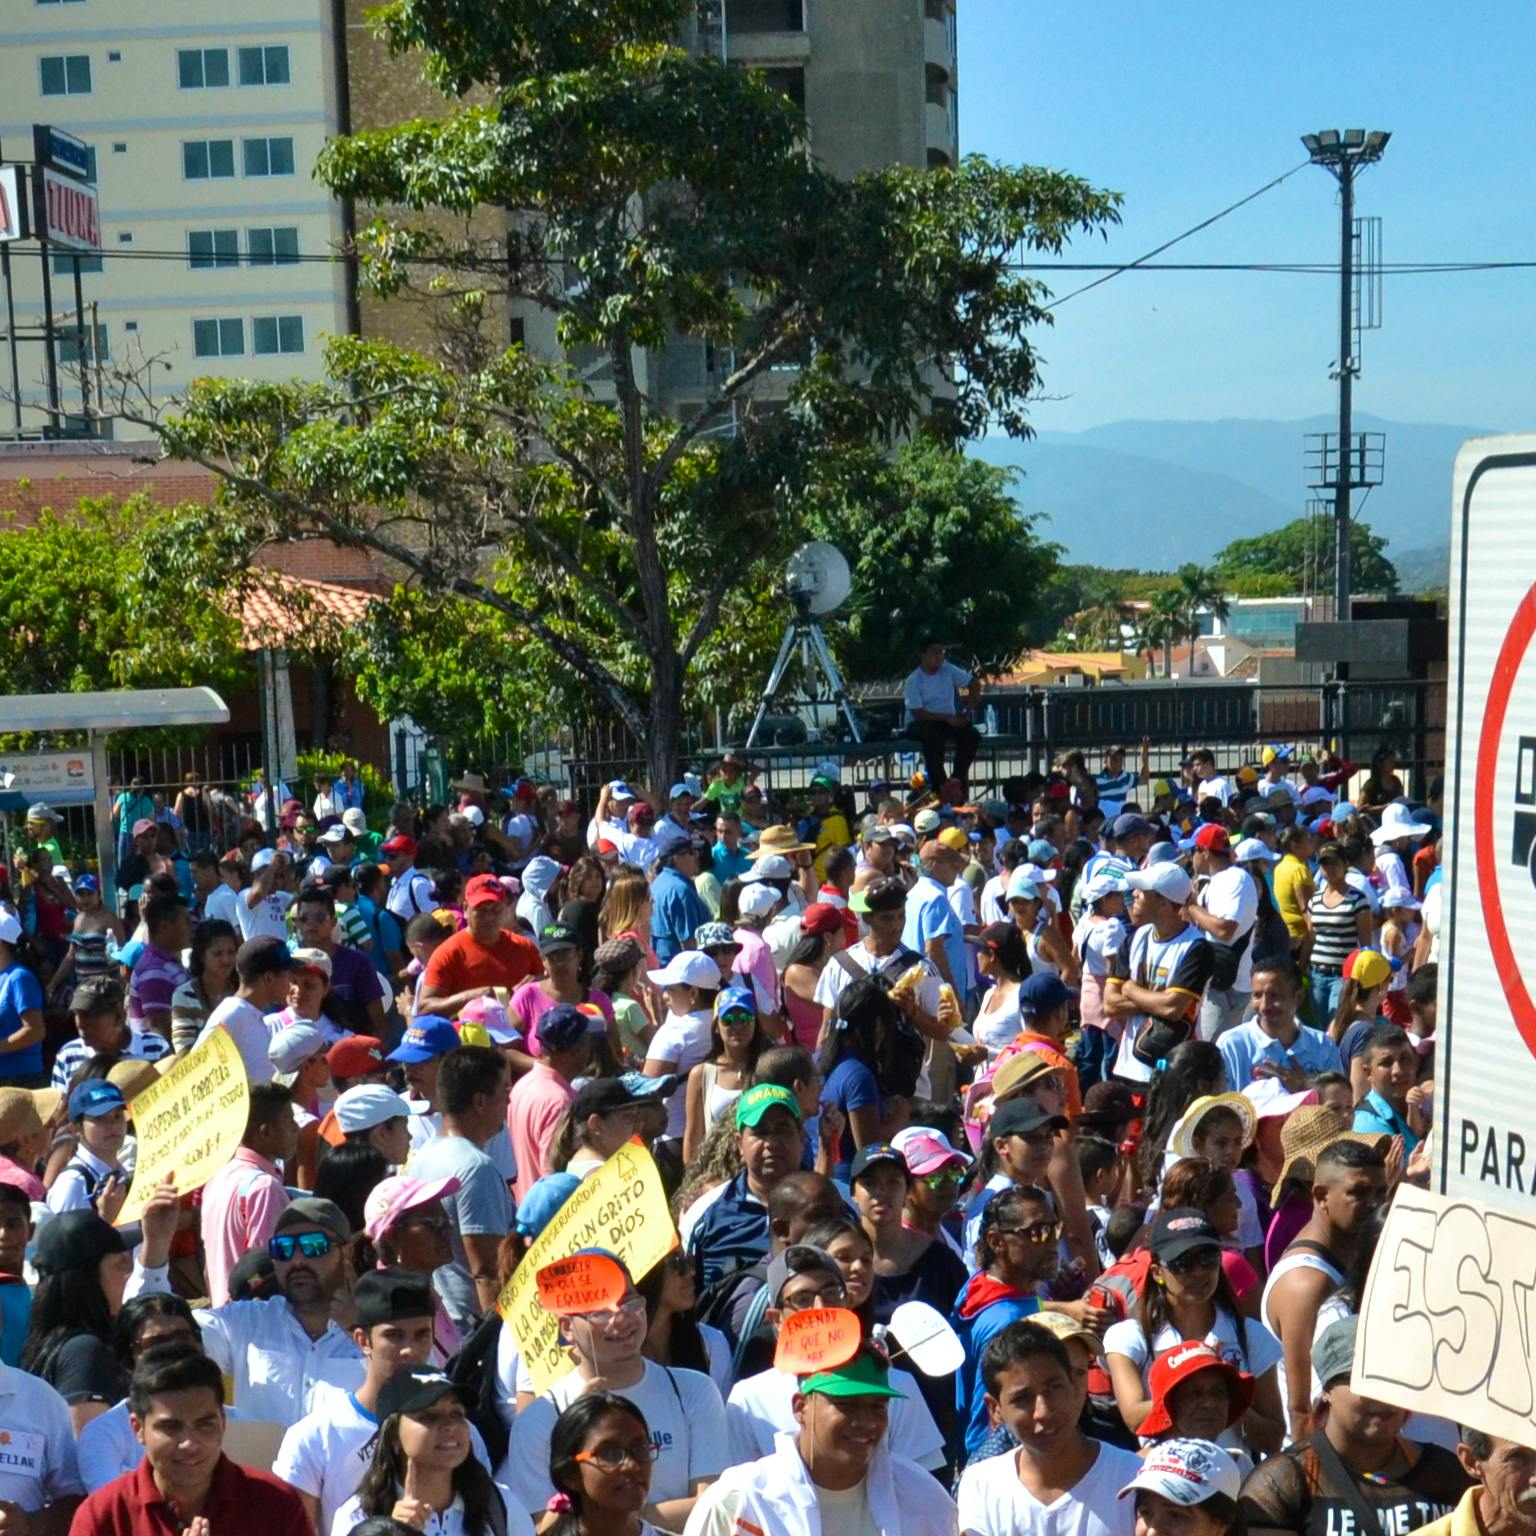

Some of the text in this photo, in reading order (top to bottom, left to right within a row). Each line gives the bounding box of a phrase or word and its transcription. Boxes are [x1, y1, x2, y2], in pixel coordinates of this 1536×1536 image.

[46, 180, 98, 247] TIUNA
[519, 1263, 532, 1287] DE
[529, 1246, 543, 1271] LA
[540, 1176, 603, 1255] MISERICORDIA
[608, 1206, 647, 1245] DIOS
[514, 1315, 533, 1343] LA
[596, 1179, 646, 1228] GRITO
[578, 1272, 594, 1287] SE
[555, 1288, 611, 1309] EQUIVOCA
